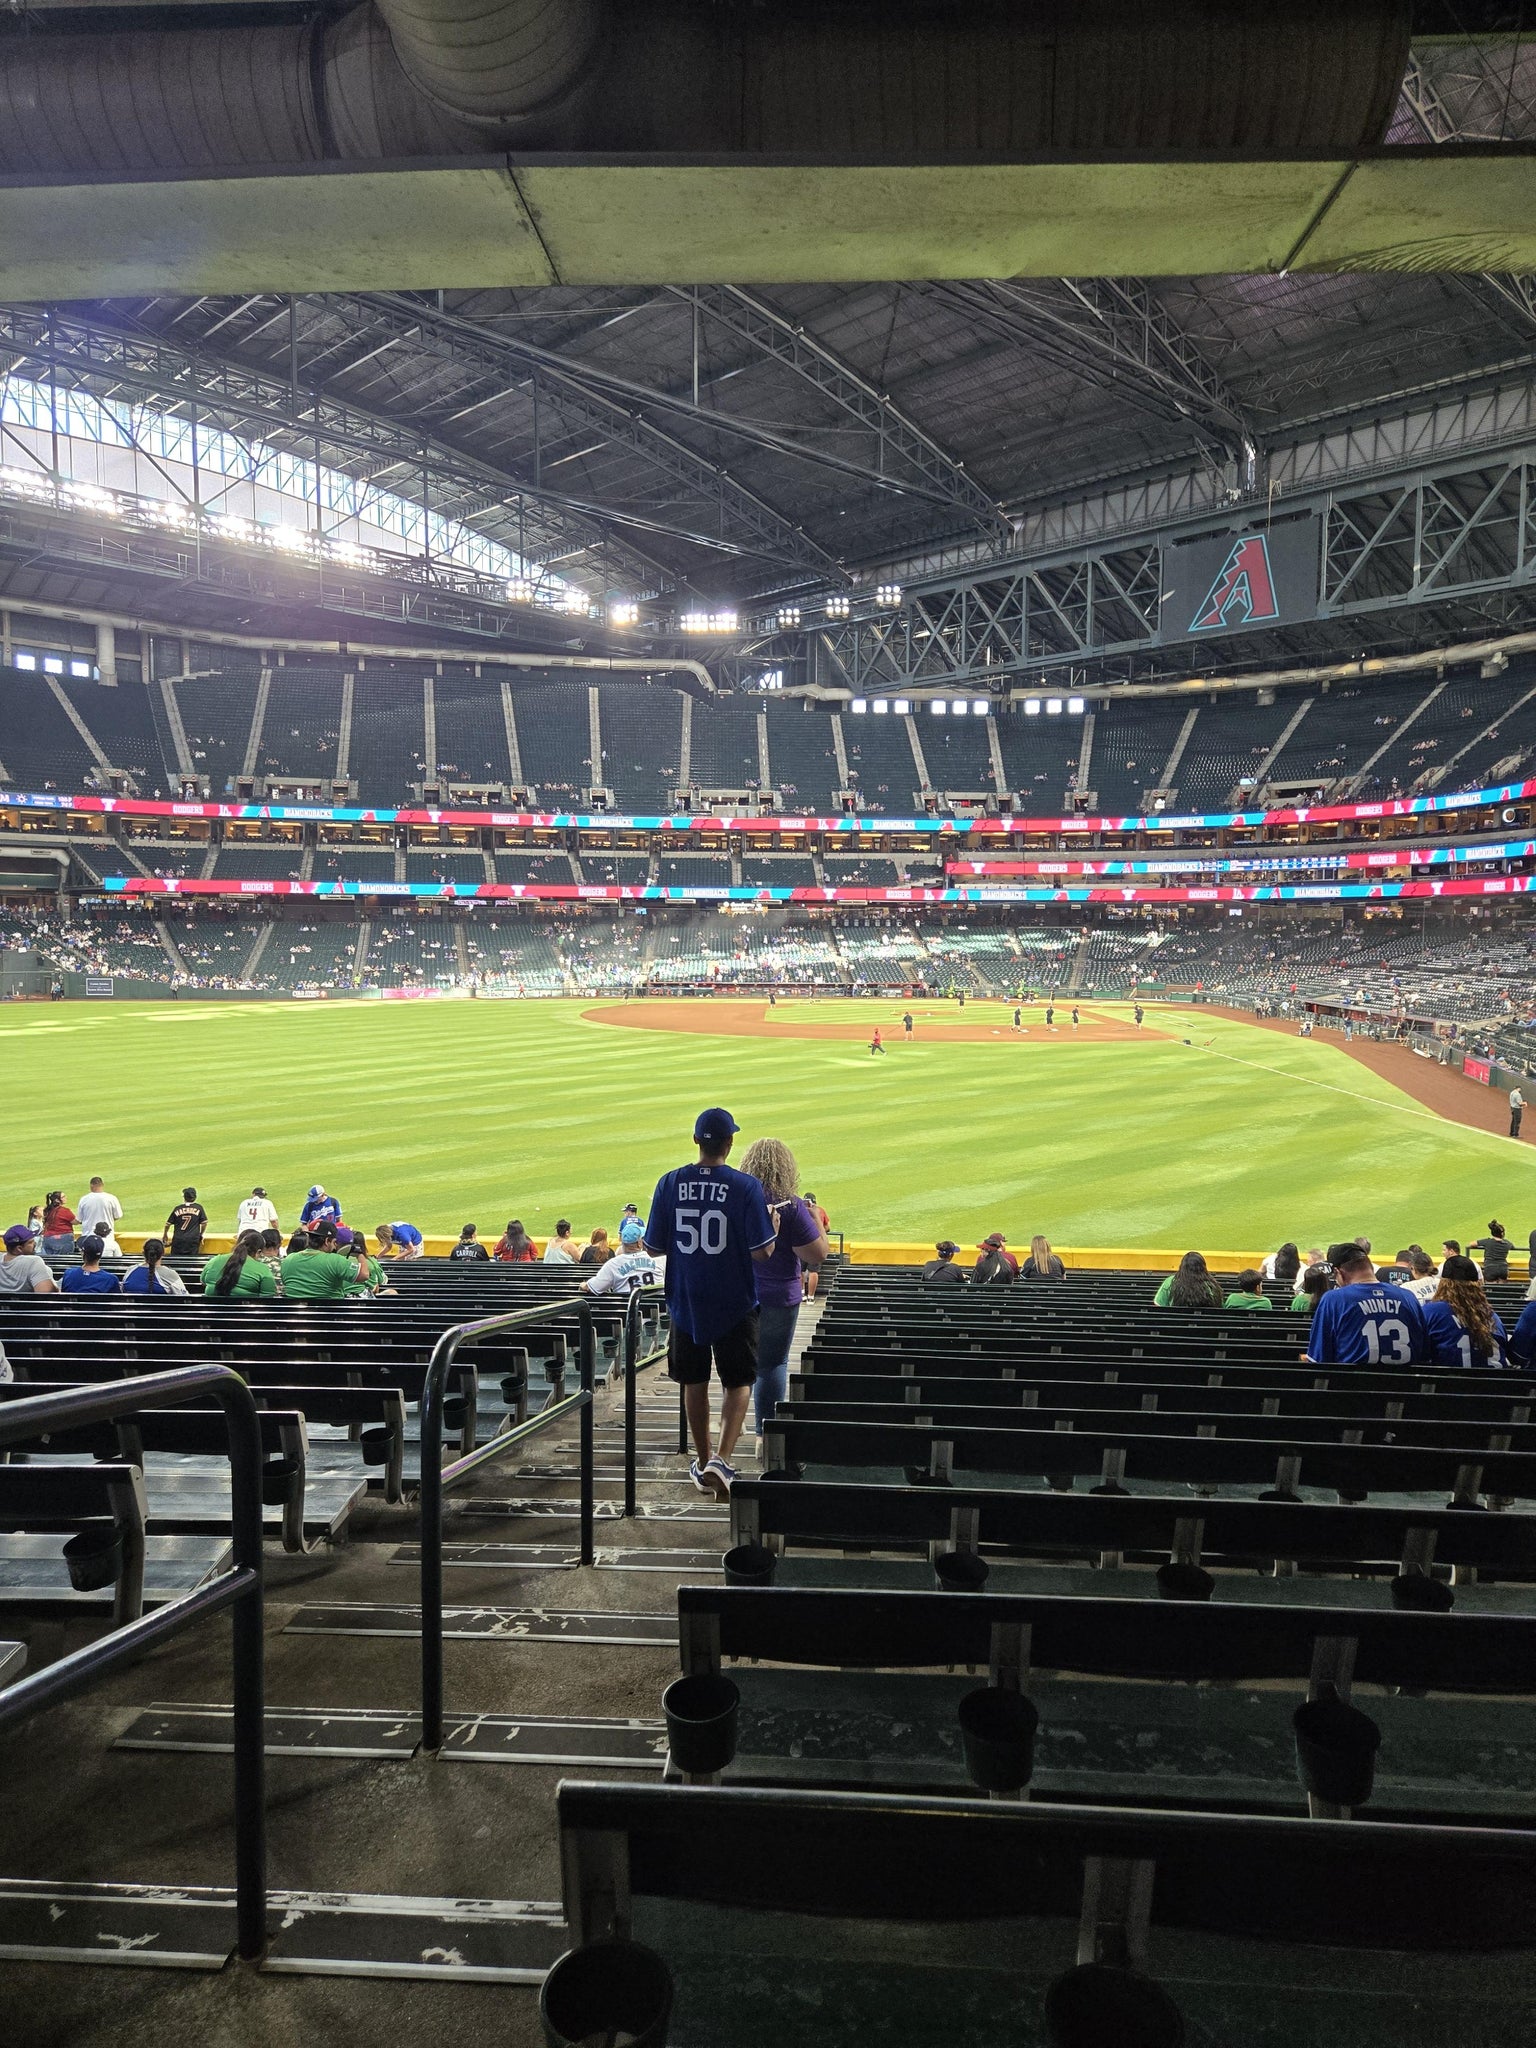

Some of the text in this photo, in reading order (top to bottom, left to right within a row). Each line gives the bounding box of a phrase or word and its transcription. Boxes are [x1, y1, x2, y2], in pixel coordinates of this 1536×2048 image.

[678, 1182, 729, 1203] BETTS
[249, 1208, 257, 1220] 4
[180, 1215, 191, 1230] 7
[676, 1208, 727, 1254] 50
[456, 1250, 477, 1258] CARROLL
[1389, 1272, 1410, 1281] CHAOS
[1358, 1299, 1402, 1315] MUNCY
[1361, 1319, 1411, 1365] 13
